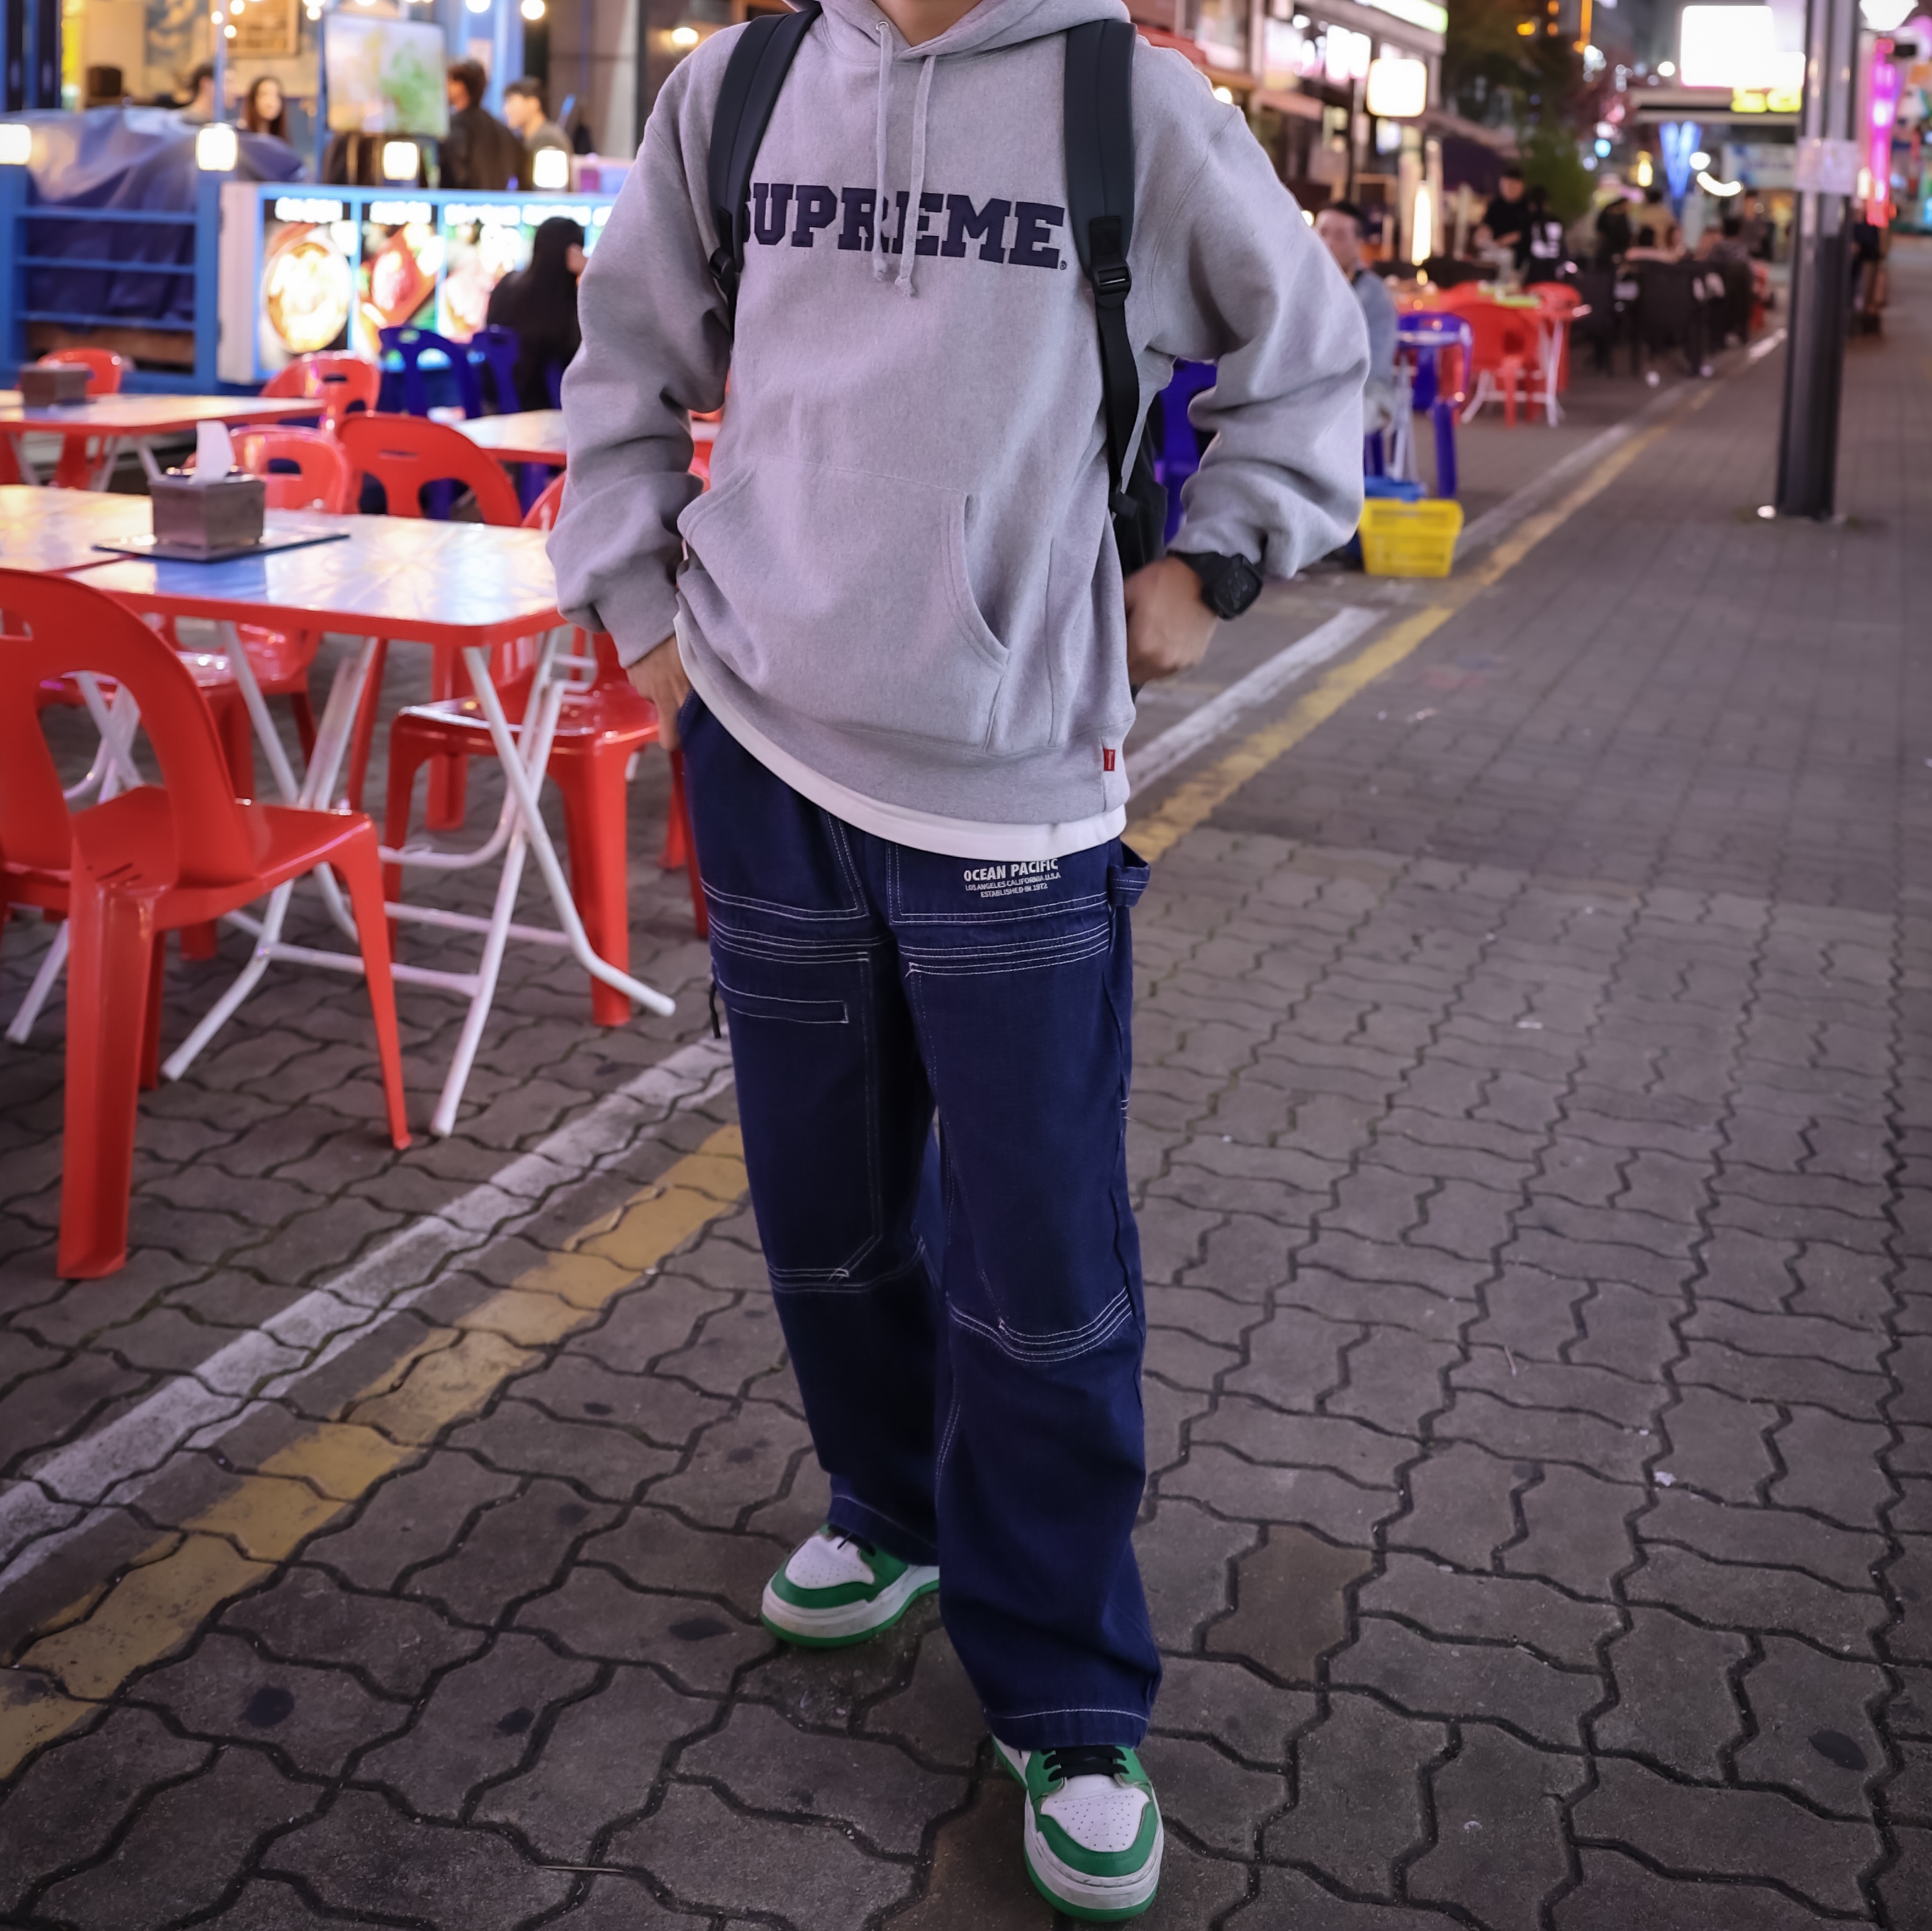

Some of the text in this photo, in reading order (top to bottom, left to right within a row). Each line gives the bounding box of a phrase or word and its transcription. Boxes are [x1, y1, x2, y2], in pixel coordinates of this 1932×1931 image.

[744, 183, 1065, 269] UPREME
[964, 859, 1059, 882] OCEAN PACIFIC
[981, 886, 1024, 898] ESTABLISHED
[1032, 882, 1048, 892] 1972
